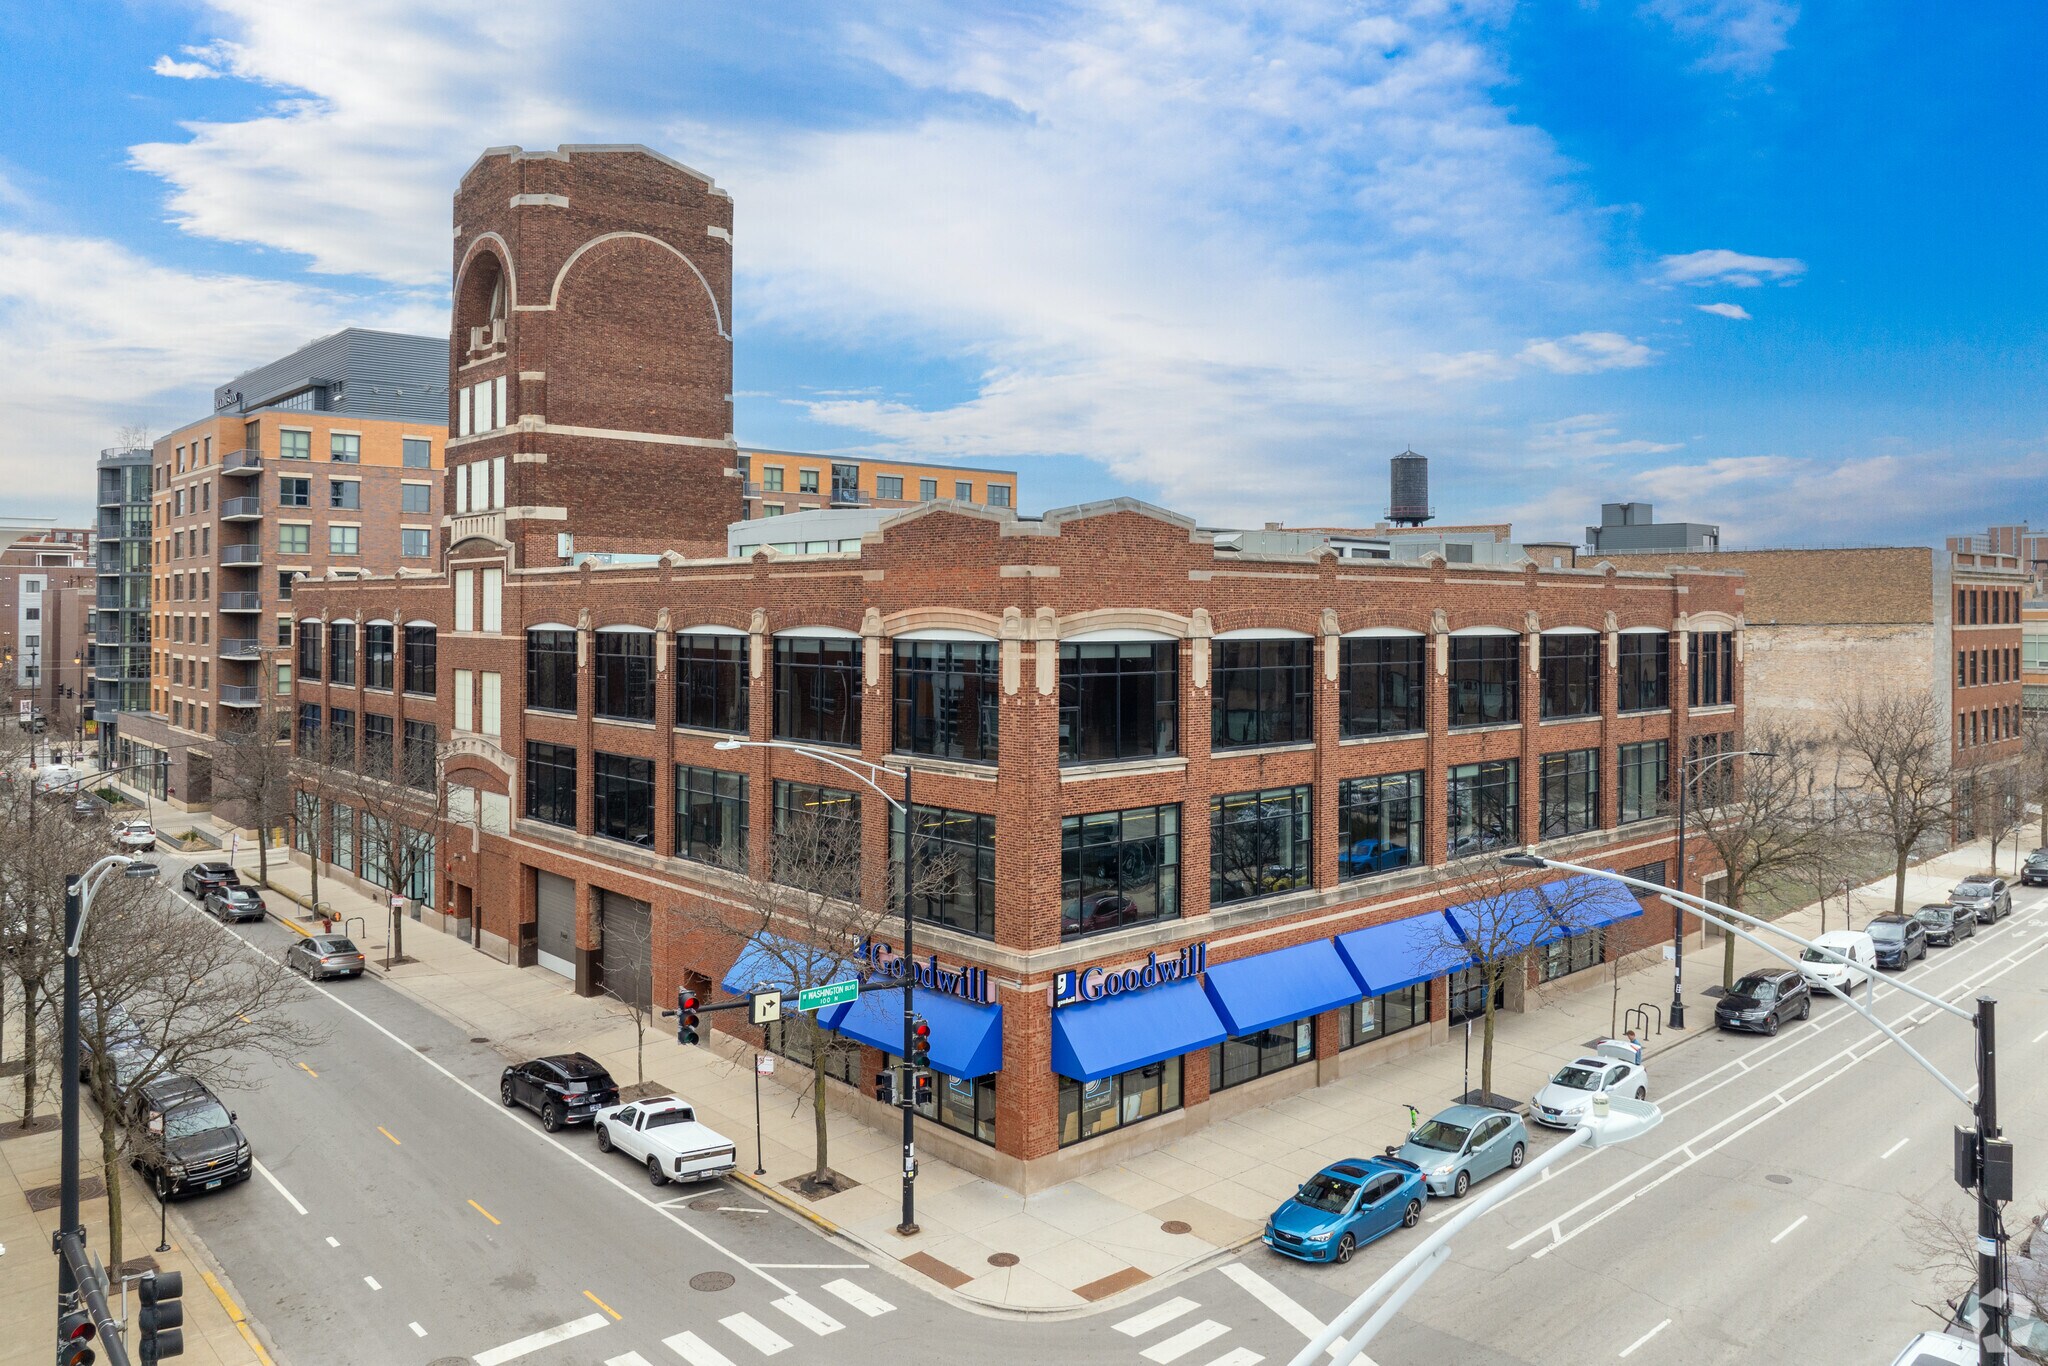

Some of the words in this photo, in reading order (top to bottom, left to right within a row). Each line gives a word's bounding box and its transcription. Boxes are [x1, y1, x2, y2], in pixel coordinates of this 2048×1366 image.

[808, 986, 844, 1000] WASHINGTON
[872, 943, 988, 1004] Goodwill
[1080, 941, 1207, 1001] Goodwill
